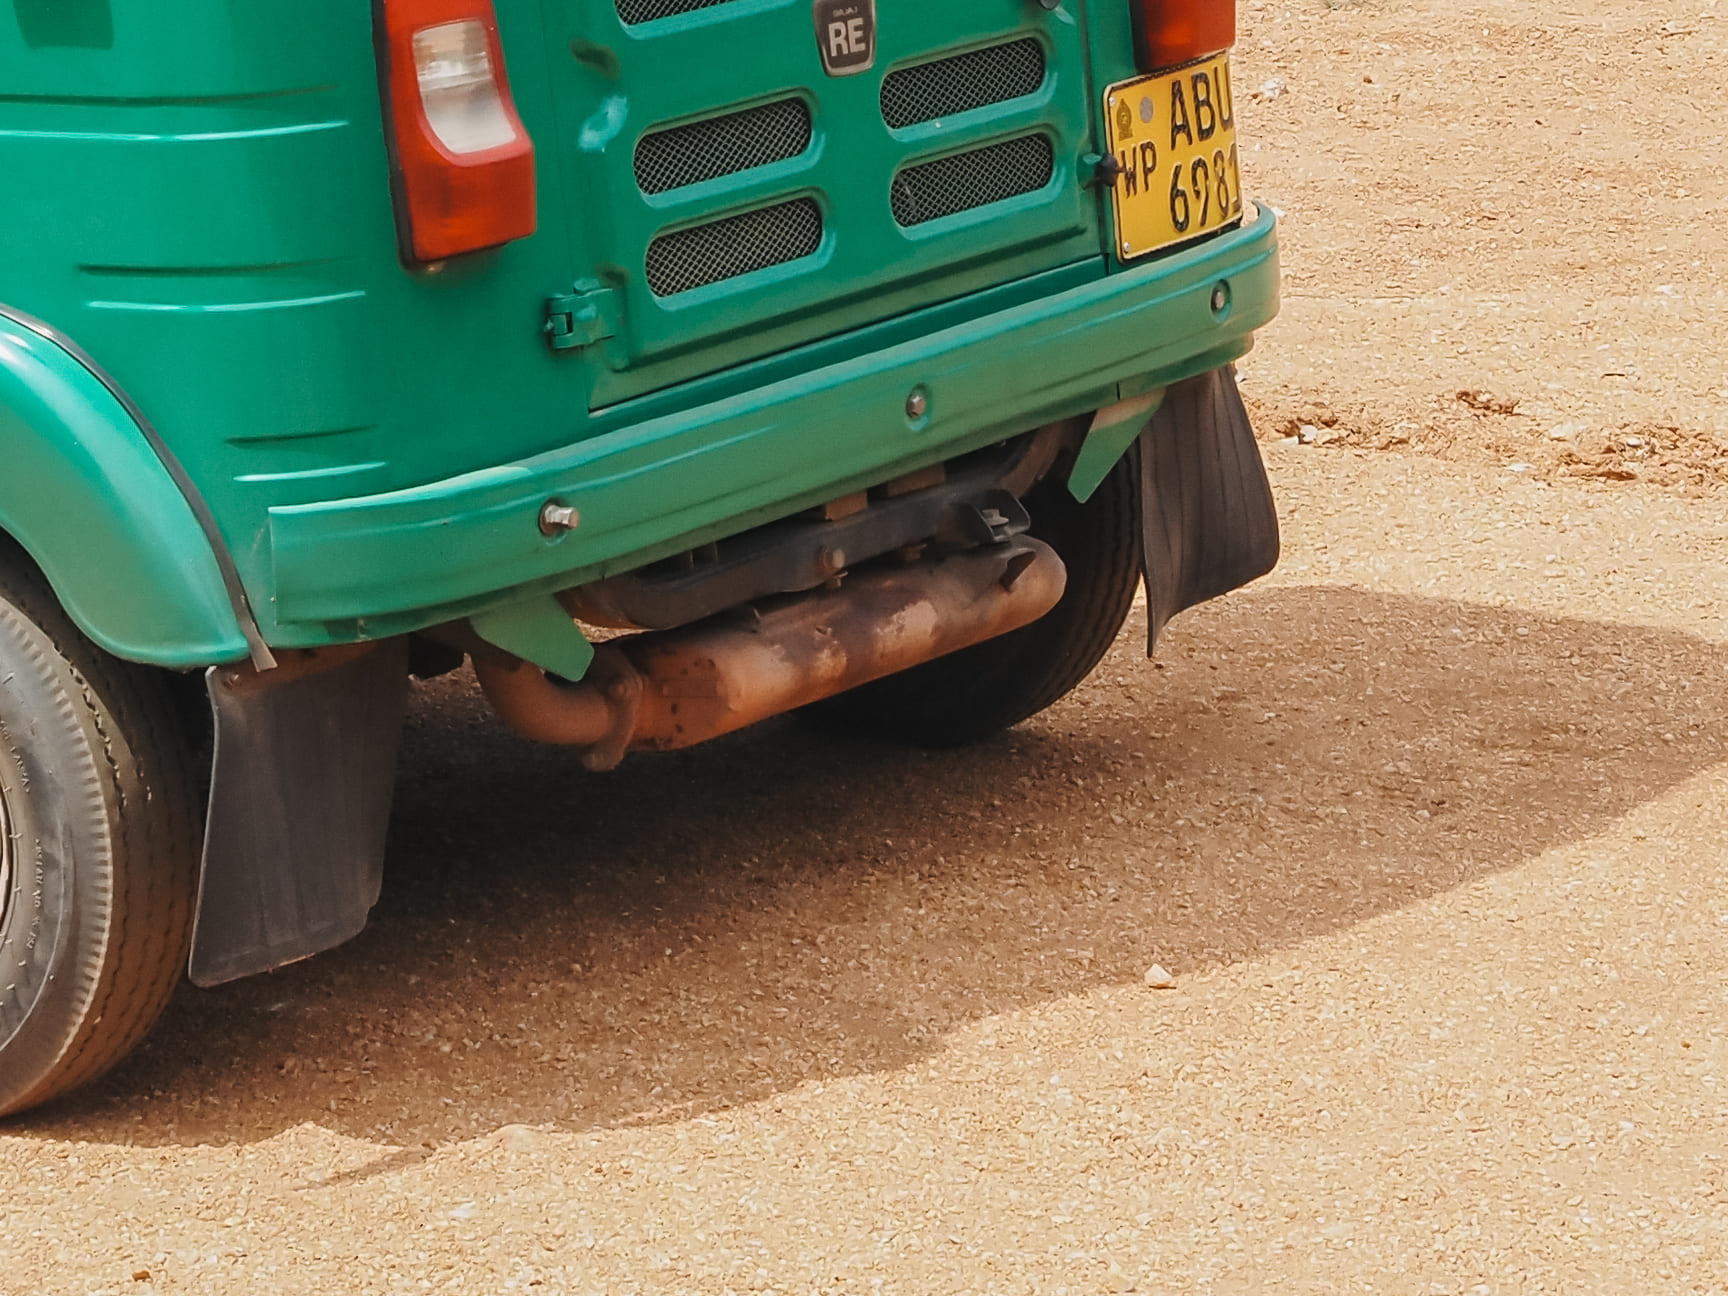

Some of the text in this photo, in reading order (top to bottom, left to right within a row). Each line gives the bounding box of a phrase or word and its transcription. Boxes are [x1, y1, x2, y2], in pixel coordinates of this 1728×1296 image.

[828, 18, 866, 57] RE
[1170, 62, 1234, 151] ABU
[1119, 141, 1157, 198] WP
[1169, 144, 1241, 233] 6981
